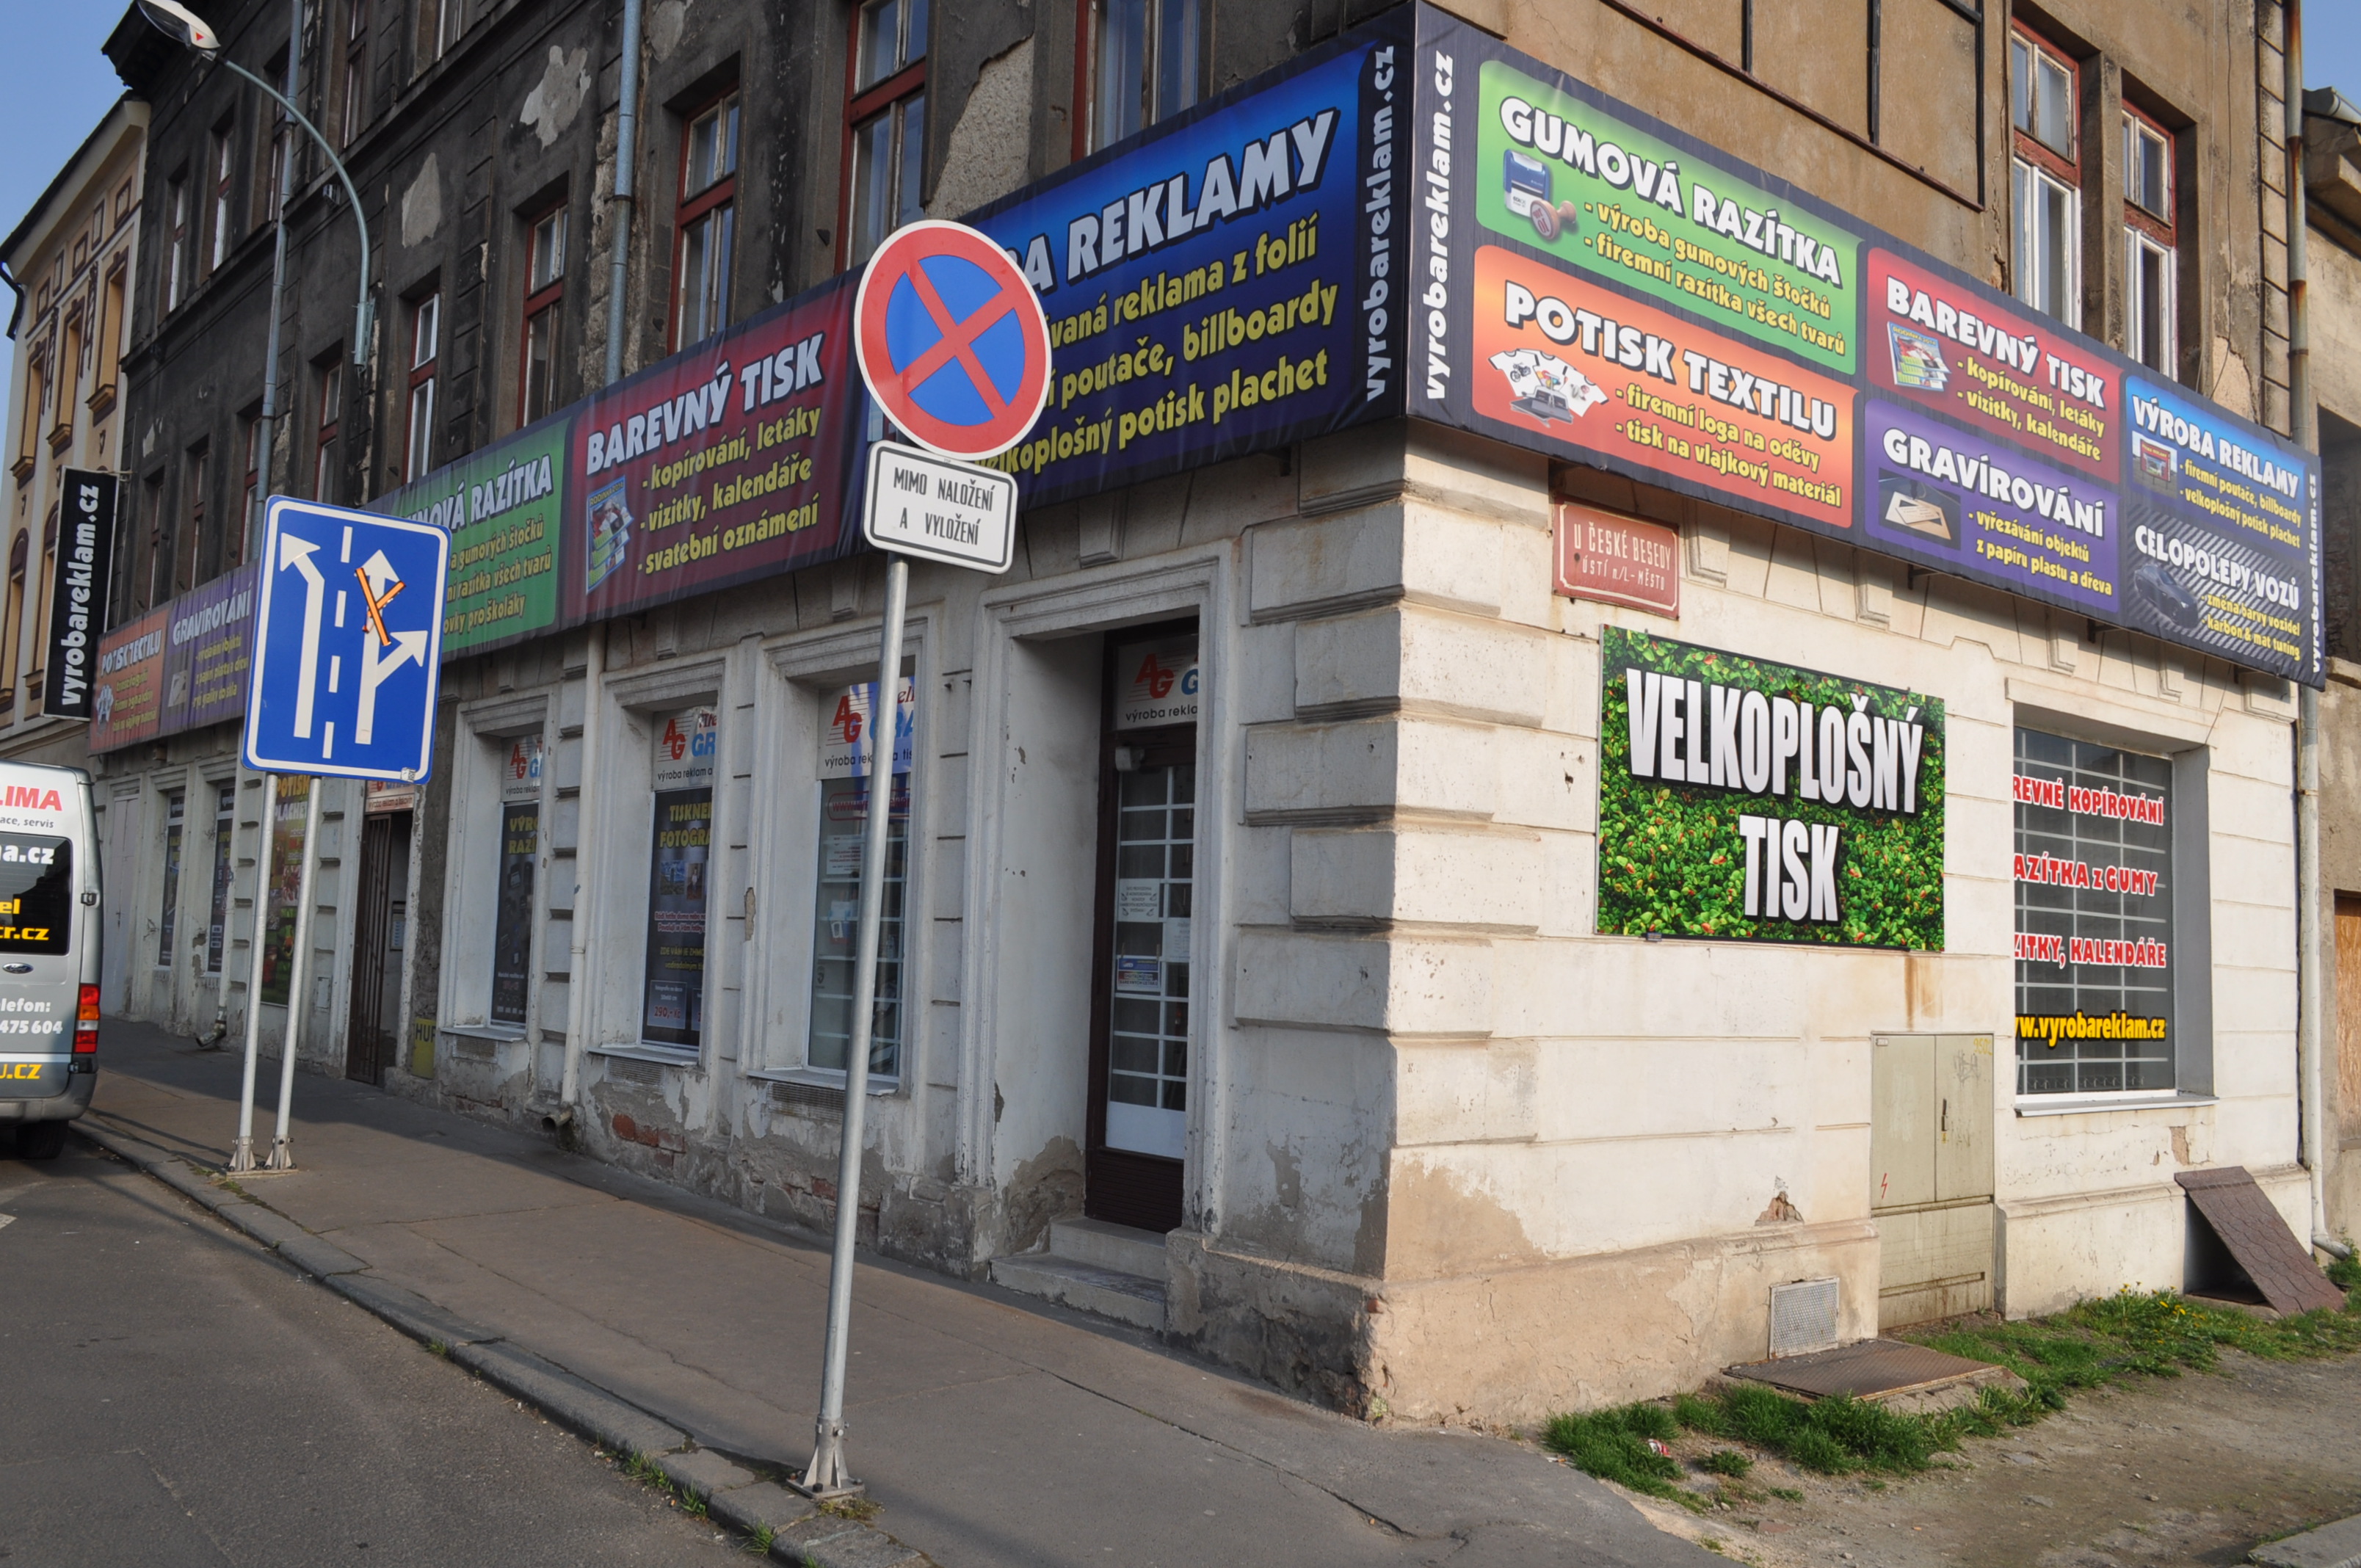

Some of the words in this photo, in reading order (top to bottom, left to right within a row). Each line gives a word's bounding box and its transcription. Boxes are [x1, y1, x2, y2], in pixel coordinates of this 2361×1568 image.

[1067, 108, 1339, 283] REKLAMY
[1363, 46, 1394, 402] vyrobareklam.cz
[1423, 50, 1454, 399] vyrobareklam.cz
[1500, 96, 1684, 216] GUMOVÁ
[1693, 184, 1843, 287] RAZÍTKA
[1114, 260, 1224, 327] reklama
[1232, 250, 1247, 285] z
[1597, 203, 1670, 247] výroba
[1675, 238, 1769, 292] gumových
[1773, 275, 1831, 319] štočků
[1597, 233, 1672, 283] firemní
[1675, 272, 1742, 312] razítka
[1747, 297, 1796, 334] všech
[1802, 319, 1846, 356] tvarů
[1062, 336, 1175, 411] poutače,
[1183, 282, 1338, 363] billboardy
[1505, 281, 1675, 383] POTISK
[1684, 350, 1836, 440] TEXTILU
[1887, 275, 2040, 375] BAREVNÝ
[2046, 352, 2106, 410] TISK
[587, 360, 732, 476] BAREVNÝ
[739, 333, 825, 412] TISK
[1119, 386, 1205, 445] potisk
[1213, 348, 1327, 425] plachet
[1627, 384, 1694, 429] firemní
[1699, 408, 1738, 443] loga
[1744, 432, 1765, 452] na
[1770, 438, 1819, 473] oděvy
[1967, 356, 2056, 416] kopírování,
[2060, 399, 2105, 438] letáky
[1967, 389, 2022, 431] vizitky,
[2026, 412, 2101, 461] kalendáře
[651, 427, 750, 490] kopírování,
[757, 407, 821, 451] letáky
[1626, 419, 1664, 449] tisk
[1667, 435, 1691, 459] na
[1695, 444, 1769, 488] vlajkový
[1773, 471, 1841, 507] materiál
[2132, 395, 2216, 461] VÝROBA
[2219, 438, 2299, 498] REKLAMY
[471, 454, 552, 524] RAZÍTKA
[649, 495, 706, 531] vizitky,
[712, 451, 812, 512] kalendáře
[893, 467, 927, 496] MIMO
[937, 478, 995, 512] NALOŽENÍ
[1883, 428, 2106, 540] GRAVÍROVÁNÍ
[2185, 458, 2218, 488] firemní
[2219, 478, 2257, 509] poutače,
[2260, 493, 2302, 528] billboardy
[2186, 488, 2241, 524] velkoplošný
[2242, 512, 2268, 534] potisk
[2270, 524, 2300, 548] plachet
[459, 529, 507, 572] gumových
[509, 514, 544, 551] štočků
[645, 525, 719, 576] svatební
[722, 493, 819, 551] oznámení
[899, 507, 907, 529] A
[925, 512, 981, 545] VYLOŽENÍ
[1574, 523, 1581, 549] U
[1589, 521, 1628, 559] ČESKÉ
[1633, 537, 1671, 570] BESEDY
[1976, 510, 2044, 546] vyřezávání
[2045, 536, 2089, 563] objektů
[61, 484, 99, 705] vyrobareklam.cz
[457, 567, 491, 600] razítka
[494, 557, 521, 587] všech
[523, 545, 552, 577] tvarů
[1583, 555, 1609, 577] ÚSTÍ
[1976, 539, 1984, 553] z
[1987, 542, 2028, 567] papíru
[2031, 555, 2068, 582] plastu
[2070, 569, 2078, 584] a
[2081, 571, 2112, 596] dřeva
[2135, 525, 2251, 592] CELOPOLEPY
[2255, 577, 2299, 611] VOZŮ
[2310, 473, 2322, 673] vyrobareklam.cz
[172, 581, 253, 646] GRAVÍROVÁNÍ
[468, 608, 484, 631] pro
[486, 592, 526, 625] školáky
[2208, 595, 2241, 615] změna
[2242, 603, 2267, 627] barvy
[2268, 614, 2301, 636] vozidel
[2208, 614, 2243, 639] karbon
[2254, 633, 2271, 649] mat
[2273, 637, 2301, 661] tuning
[1125, 708, 1165, 722] výroba
[1626, 667, 1923, 813] VELKOPLOŠNÝ
[506, 786, 523, 796] výroba
[658, 770, 681, 782] výroba
[683, 768, 706, 778] reklam
[825, 755, 855, 769] výroba
[0, 785, 62, 811] IMA
[23, 819, 54, 828] servis
[2069, 785, 2164, 825] KOPÍROVÁNÍ
[0, 844, 55, 865] a.cz
[1739, 814, 1839, 921] TISK
[2092, 868, 2103, 890] z
[2106, 865, 2158, 896] GUMY
[2070, 937, 2166, 968] KALENDÁŘE
[31, 1020, 63, 1034] 604
[2016, 1009, 2166, 1048] w.vyrobareklam.cz
